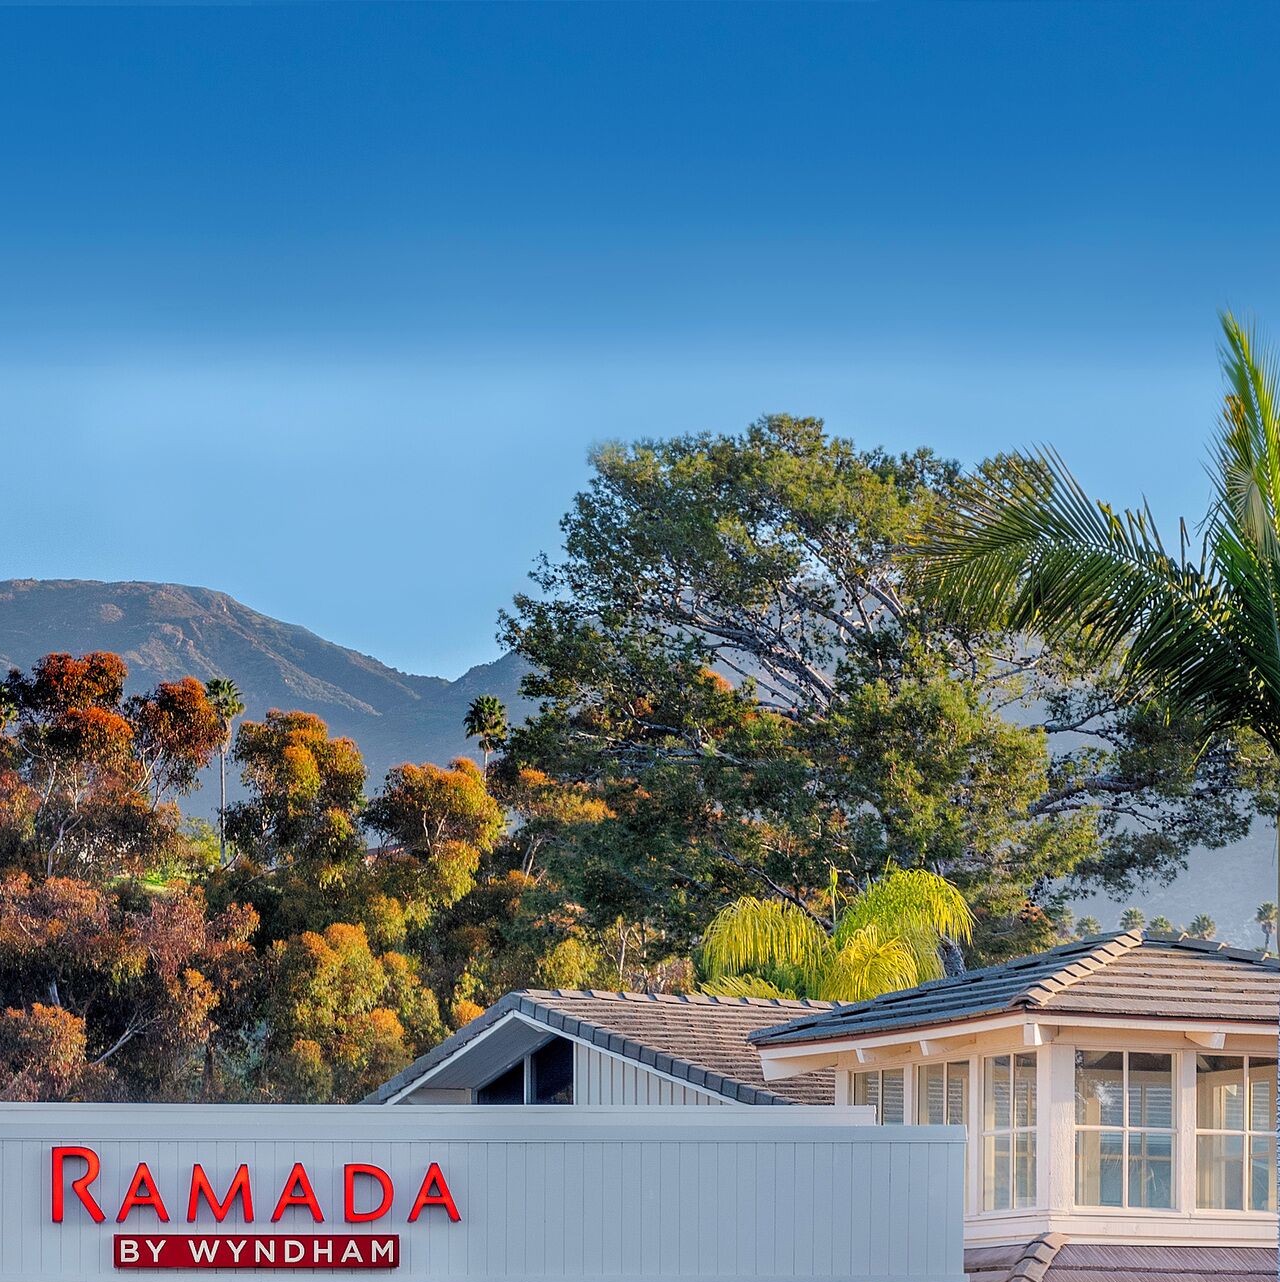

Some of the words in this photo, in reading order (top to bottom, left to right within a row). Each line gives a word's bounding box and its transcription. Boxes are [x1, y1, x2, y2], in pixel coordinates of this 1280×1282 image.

[51, 1146, 461, 1222] RAMADA
[120, 1239, 167, 1263] BY
[187, 1239, 395, 1263] WYNDHAM
